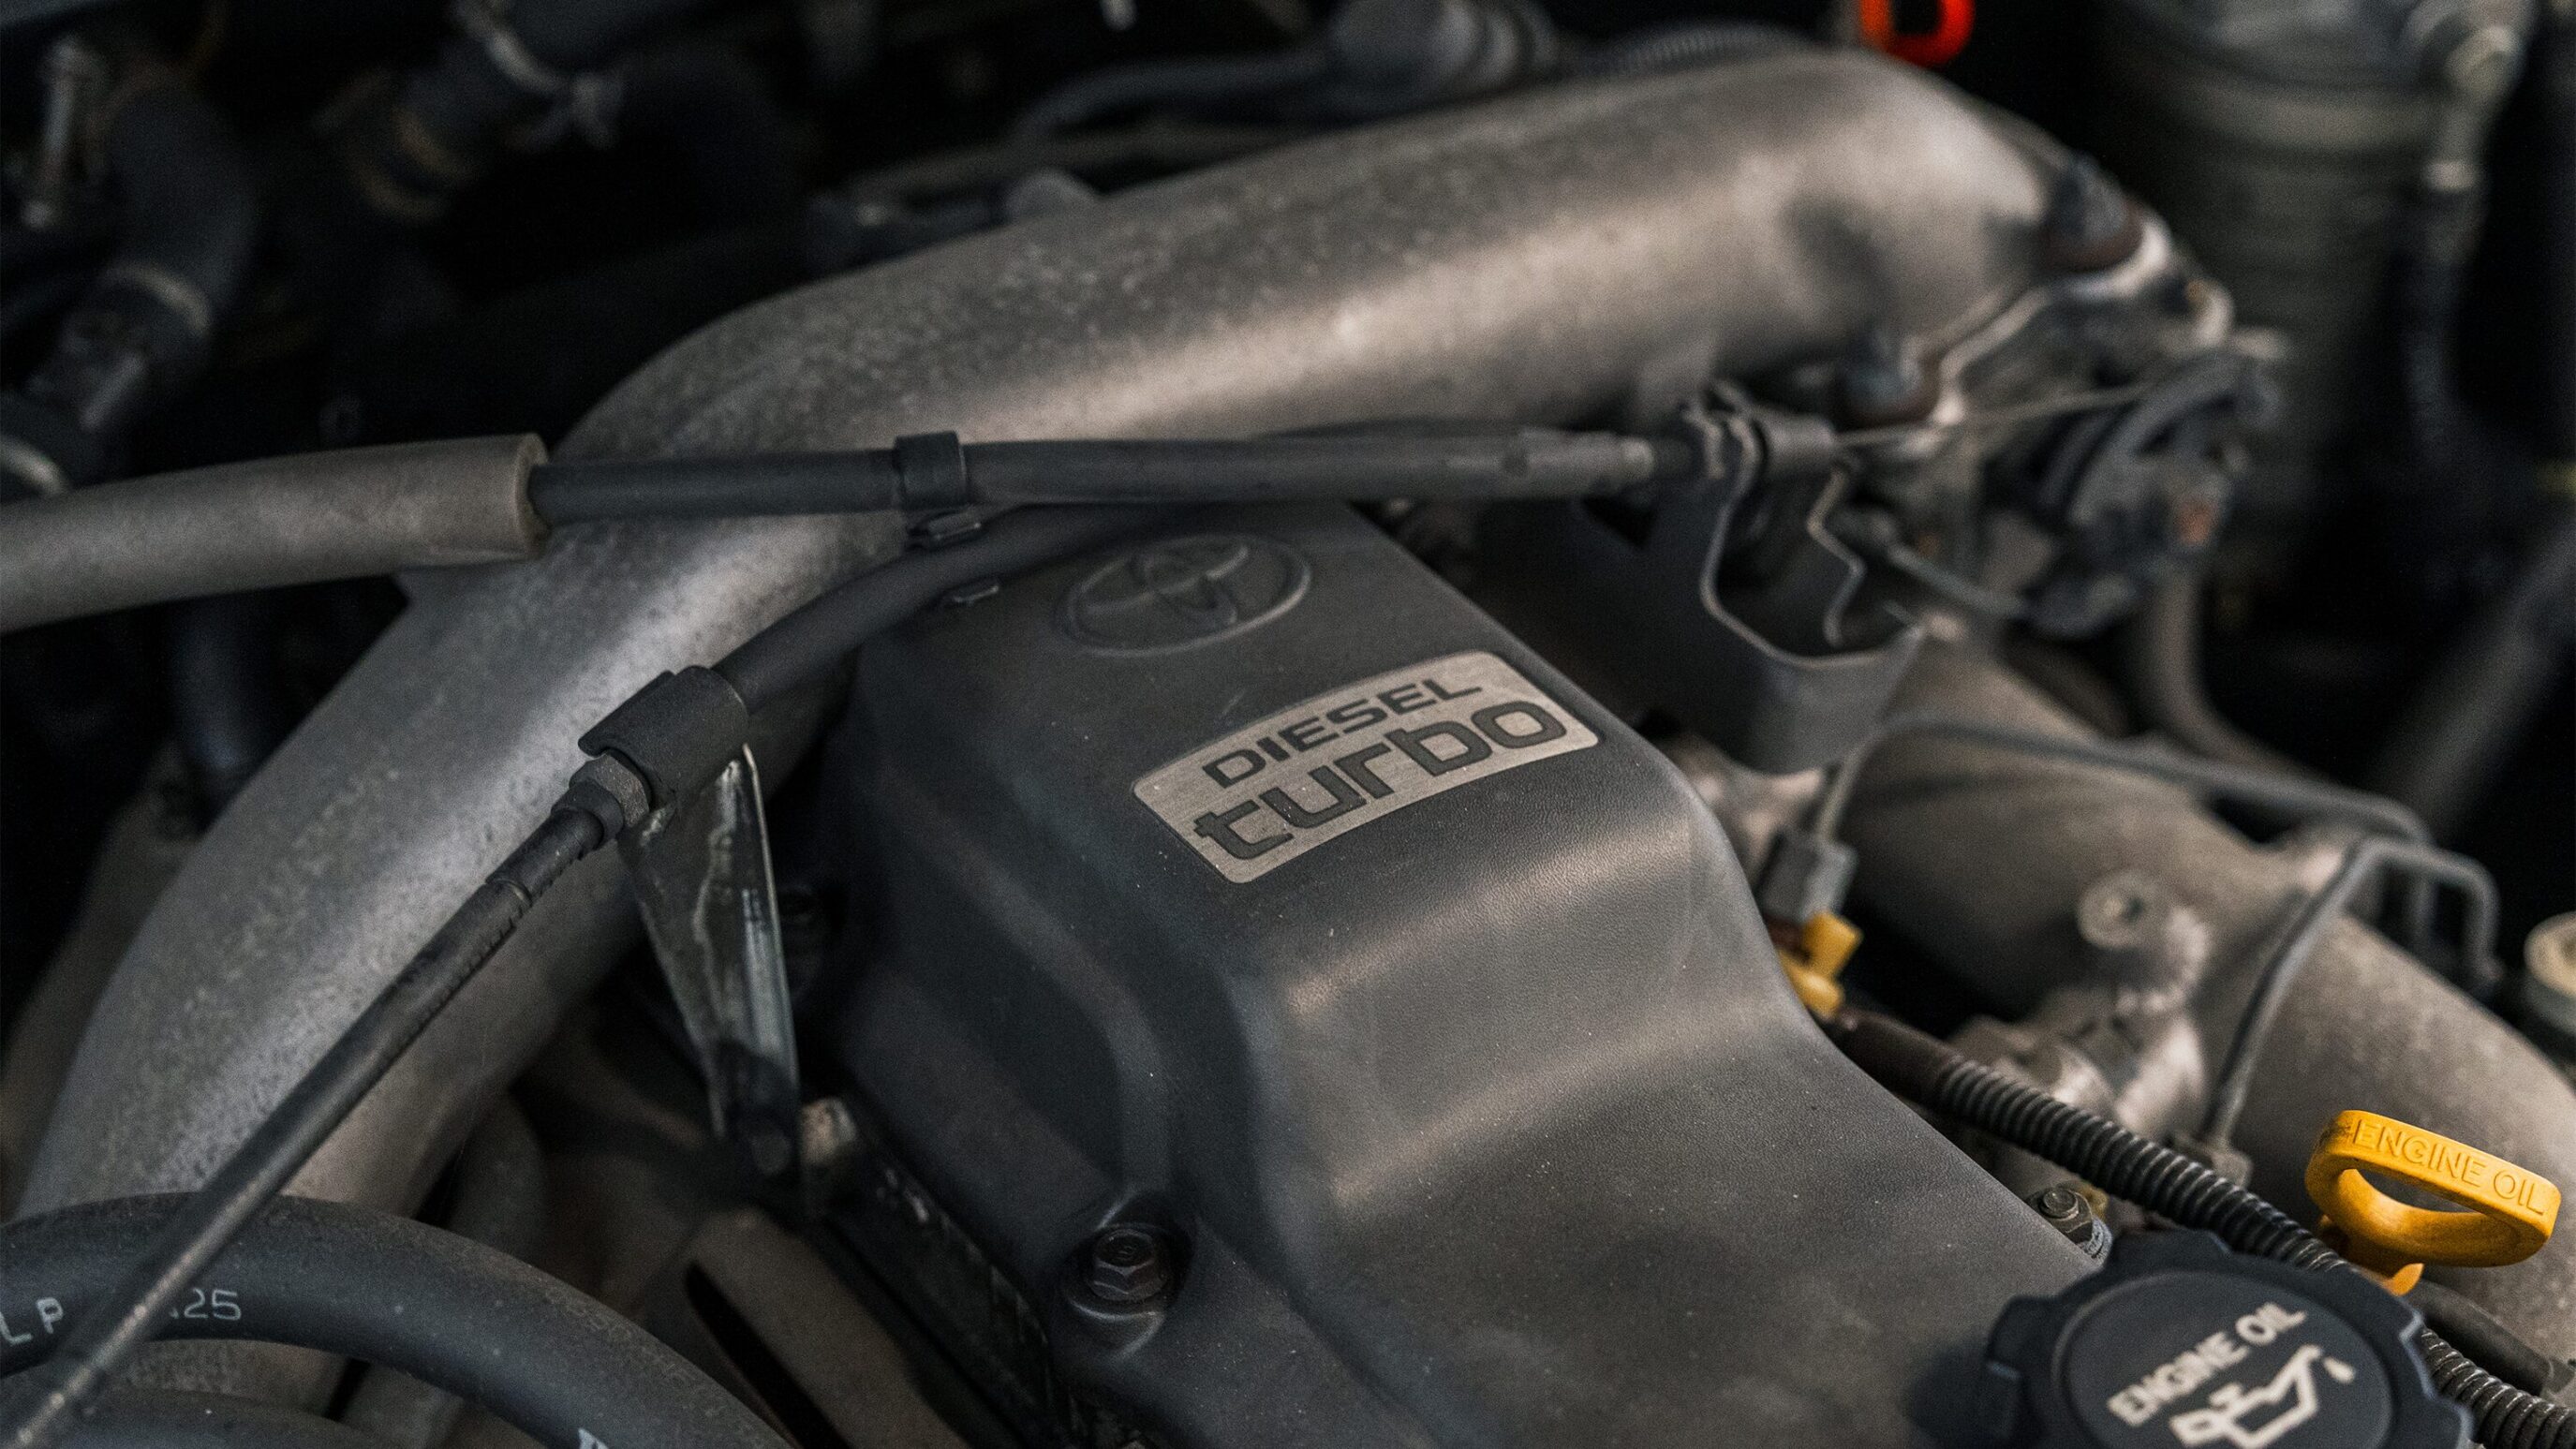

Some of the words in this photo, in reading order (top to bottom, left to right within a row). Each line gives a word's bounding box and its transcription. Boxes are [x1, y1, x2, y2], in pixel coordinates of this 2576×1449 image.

[1202, 678, 1483, 789] DIESEL
[2352, 1118, 2486, 1188] ENGINE
[2493, 1169, 2544, 1217] OIL
[2108, 1330, 2249, 1427] ENGINE
[2234, 1301, 2307, 1345] OIL
